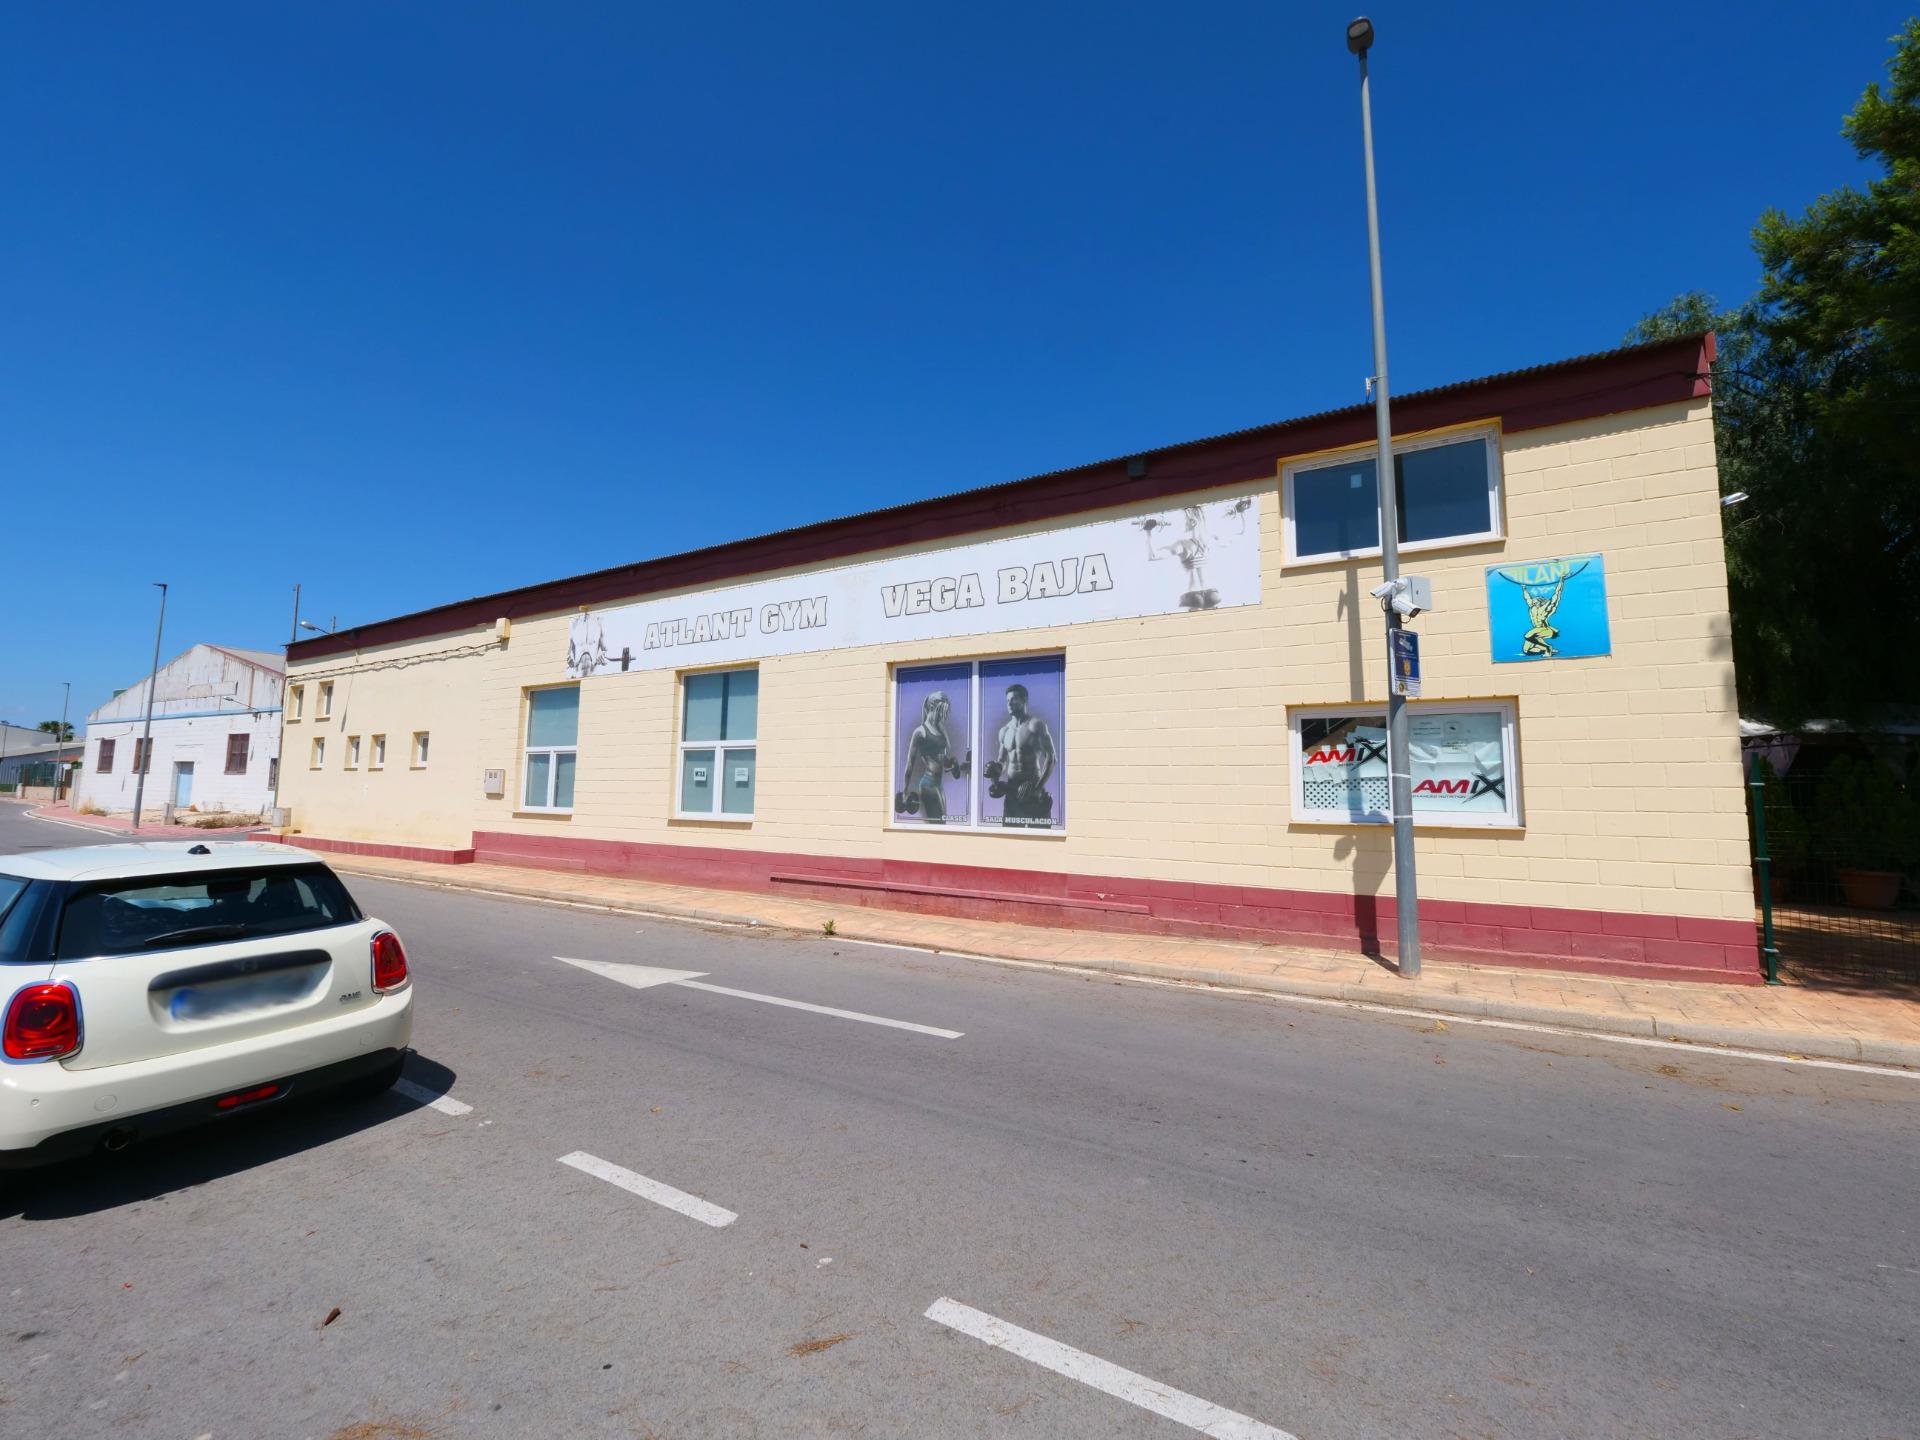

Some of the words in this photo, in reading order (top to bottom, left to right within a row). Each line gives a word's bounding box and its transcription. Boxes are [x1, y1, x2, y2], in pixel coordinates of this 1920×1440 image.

[643, 608, 752, 650] ATLANT
[759, 595, 828, 634] GYM
[881, 573, 985, 618] VEGA
[997, 553, 1114, 604] BAJA
[1306, 735, 1388, 771] AMIX
[1411, 771, 1505, 804] AMIX
[942, 814, 967, 823] CLASES
[985, 815, 1003, 823] SALA
